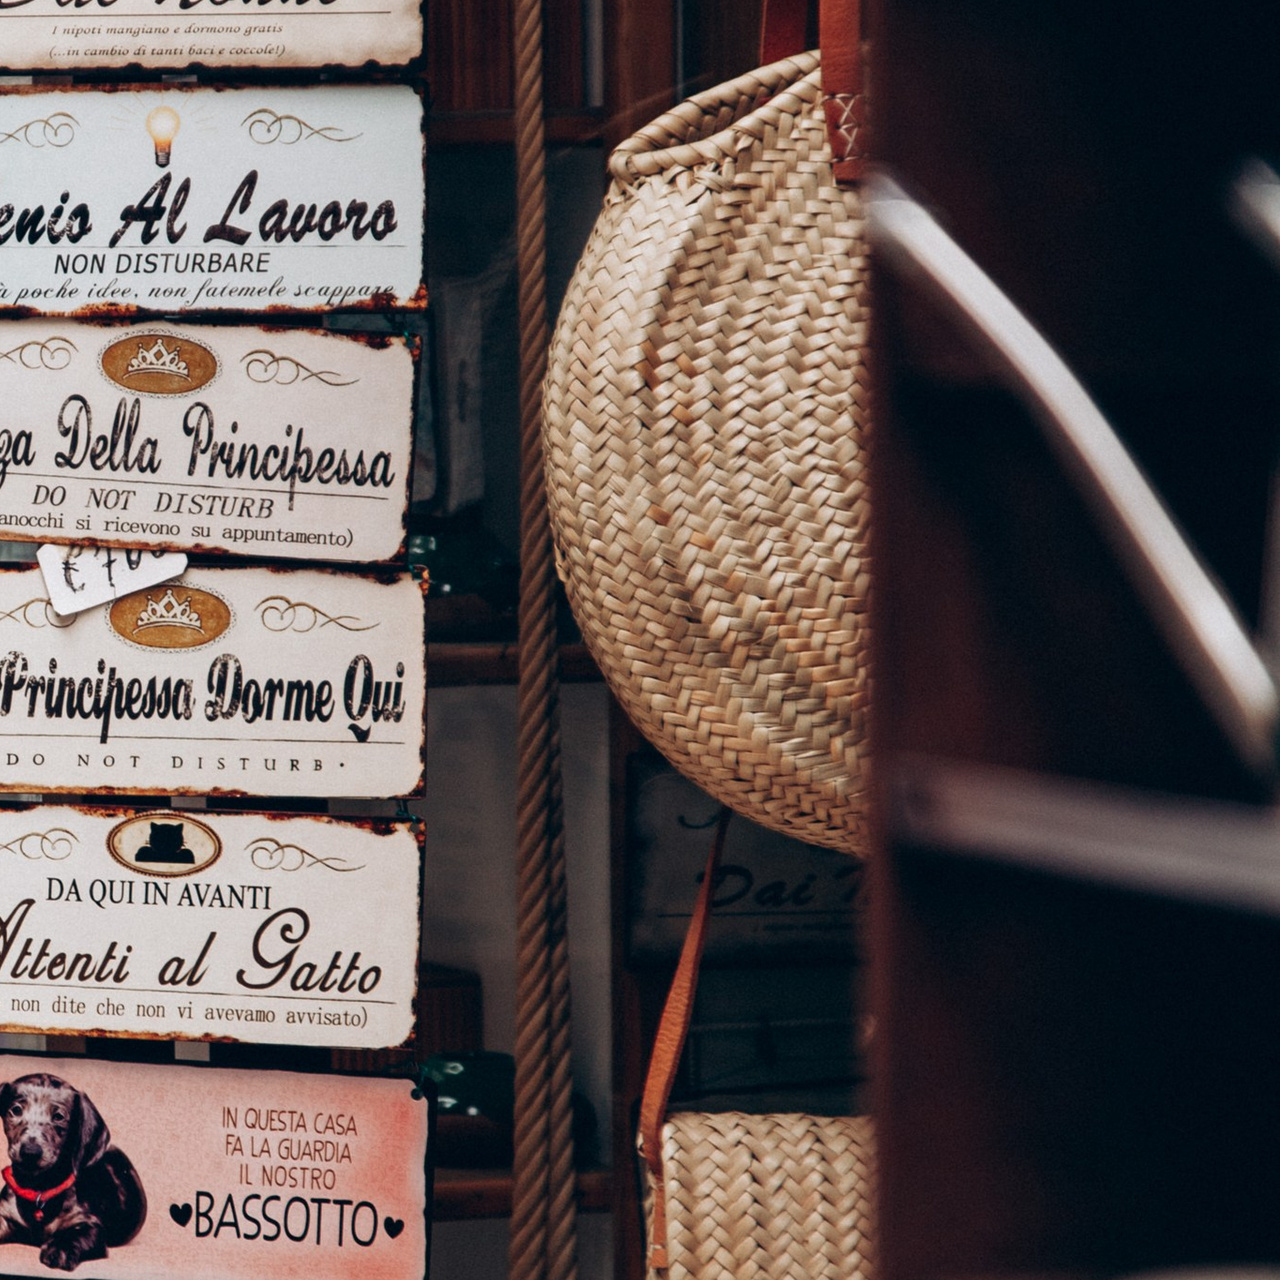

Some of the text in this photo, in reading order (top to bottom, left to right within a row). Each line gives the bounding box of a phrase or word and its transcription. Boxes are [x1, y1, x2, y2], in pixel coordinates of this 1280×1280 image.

[62, 23, 283, 37] nipoti mangiano dormono gratis
[84, 44, 286, 57] cambio tanti baci coccole!)
[110, 170, 192, 248] Al
[203, 169, 398, 246] Lavoro
[54, 252, 271, 275] NON DISTURBARE
[14, 278, 79, 305] poche
[87, 277, 139, 300] idee,
[147, 283, 187, 299] non
[193, 277, 288, 306] fatemele
[293, 282, 395, 305] scappare
[55, 393, 161, 475] Della
[182, 401, 396, 511] Principessa
[31, 484, 275, 518] DO NOT DISTURB
[76, 514, 92, 531] si
[104, 516, 181, 537] ricevono
[191, 522, 212, 538] su
[222, 521, 355, 549] appuntamento)
[205, 652, 335, 724] Dorme
[343, 654, 406, 743] Qui
[6, 753, 325, 772] DO NOT DISTURB
[46, 877, 271, 910] DA QUI IN AVANTI
[158, 931, 217, 987] al
[236, 906, 382, 995] Gatto
[11, 994, 41, 1012] non
[51, 993, 86, 1014] dite
[96, 997, 125, 1017] che
[135, 1001, 166, 1018] non
[177, 1000, 194, 1020] vi
[204, 1007, 276, 1023] avevamo
[285, 1006, 368, 1028] avvisato)
[222, 1106, 358, 1136] IN QUESTA CASA
[225, 1134, 352, 1163] FA LA GUARDIA
[239, 1163, 336, 1190] IL NOSTRO
[195, 1190, 378, 1248] BASSOTTO
